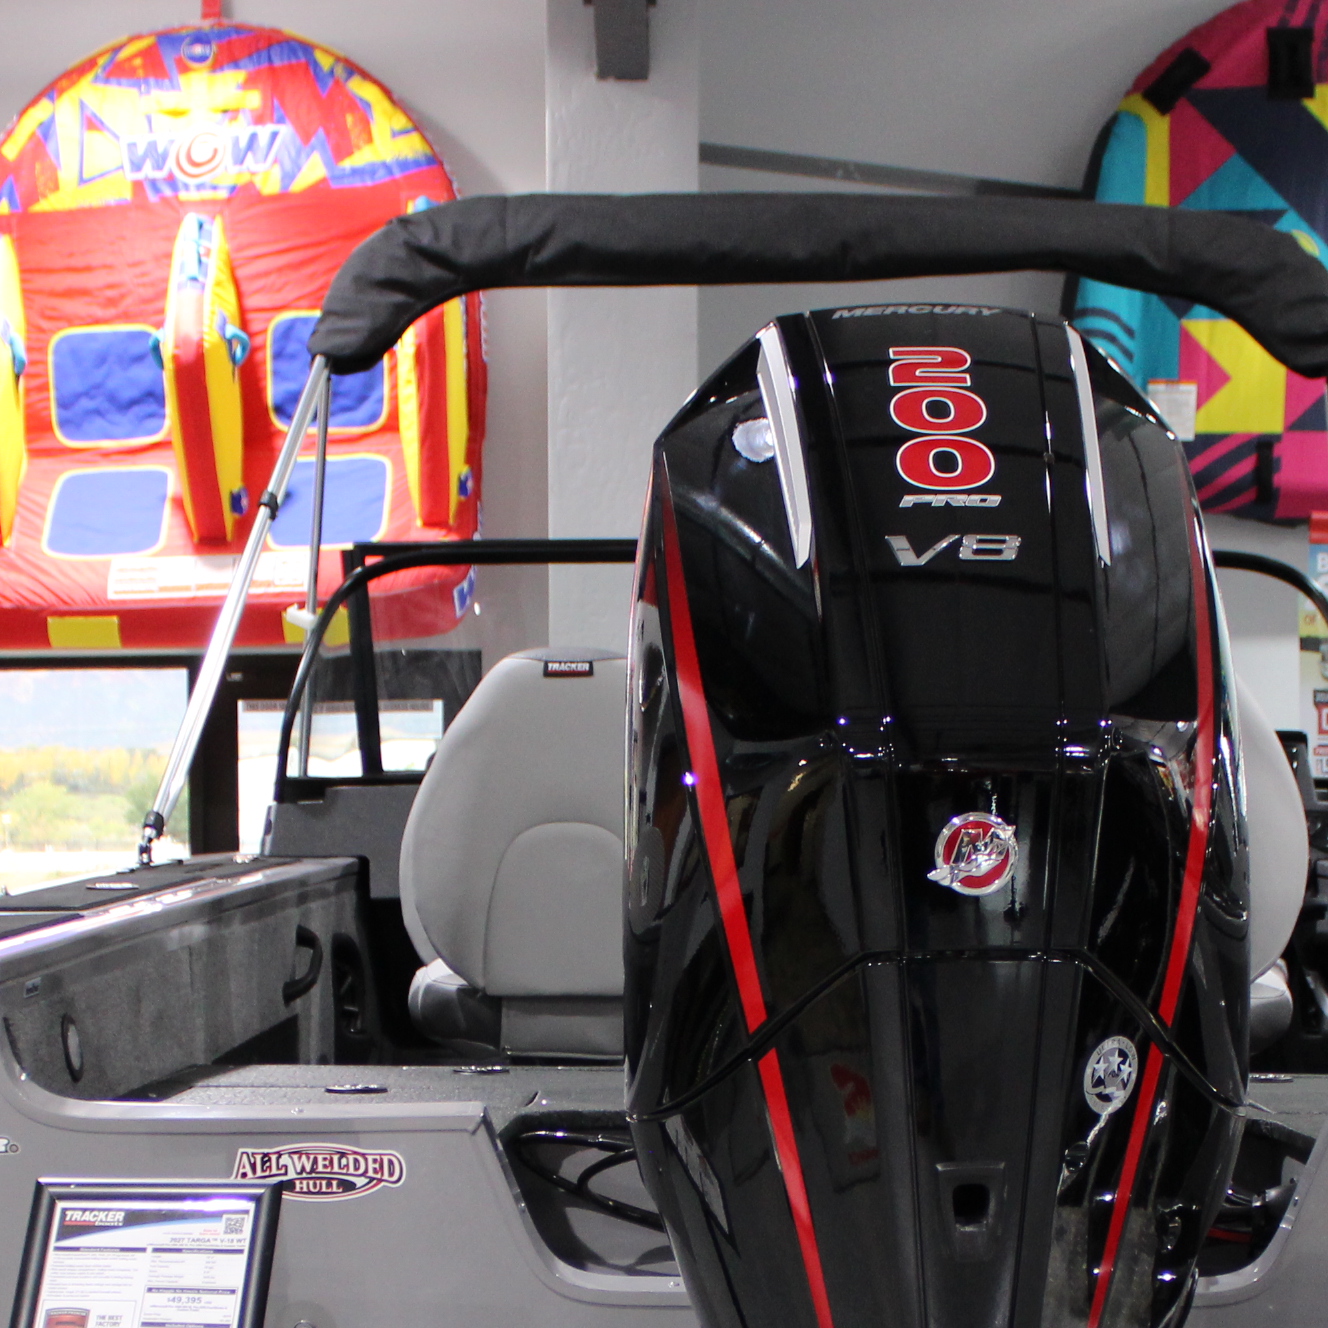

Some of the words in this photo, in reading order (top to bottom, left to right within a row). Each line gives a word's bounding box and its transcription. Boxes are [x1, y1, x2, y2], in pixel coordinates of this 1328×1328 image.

[122, 123, 288, 184] WOW
[831, 304, 1001, 319] MERCURY
[888, 346, 996, 491] 200
[899, 494, 1002, 508] PRO
[885, 533, 1022, 567] V8
[548, 662, 590, 671] TRACKER
[237, 1151, 288, 1180] ALL
[290, 1152, 401, 1183] WELDED
[294, 1179, 343, 1193] HULL
[64, 1210, 125, 1222] TRACKER
